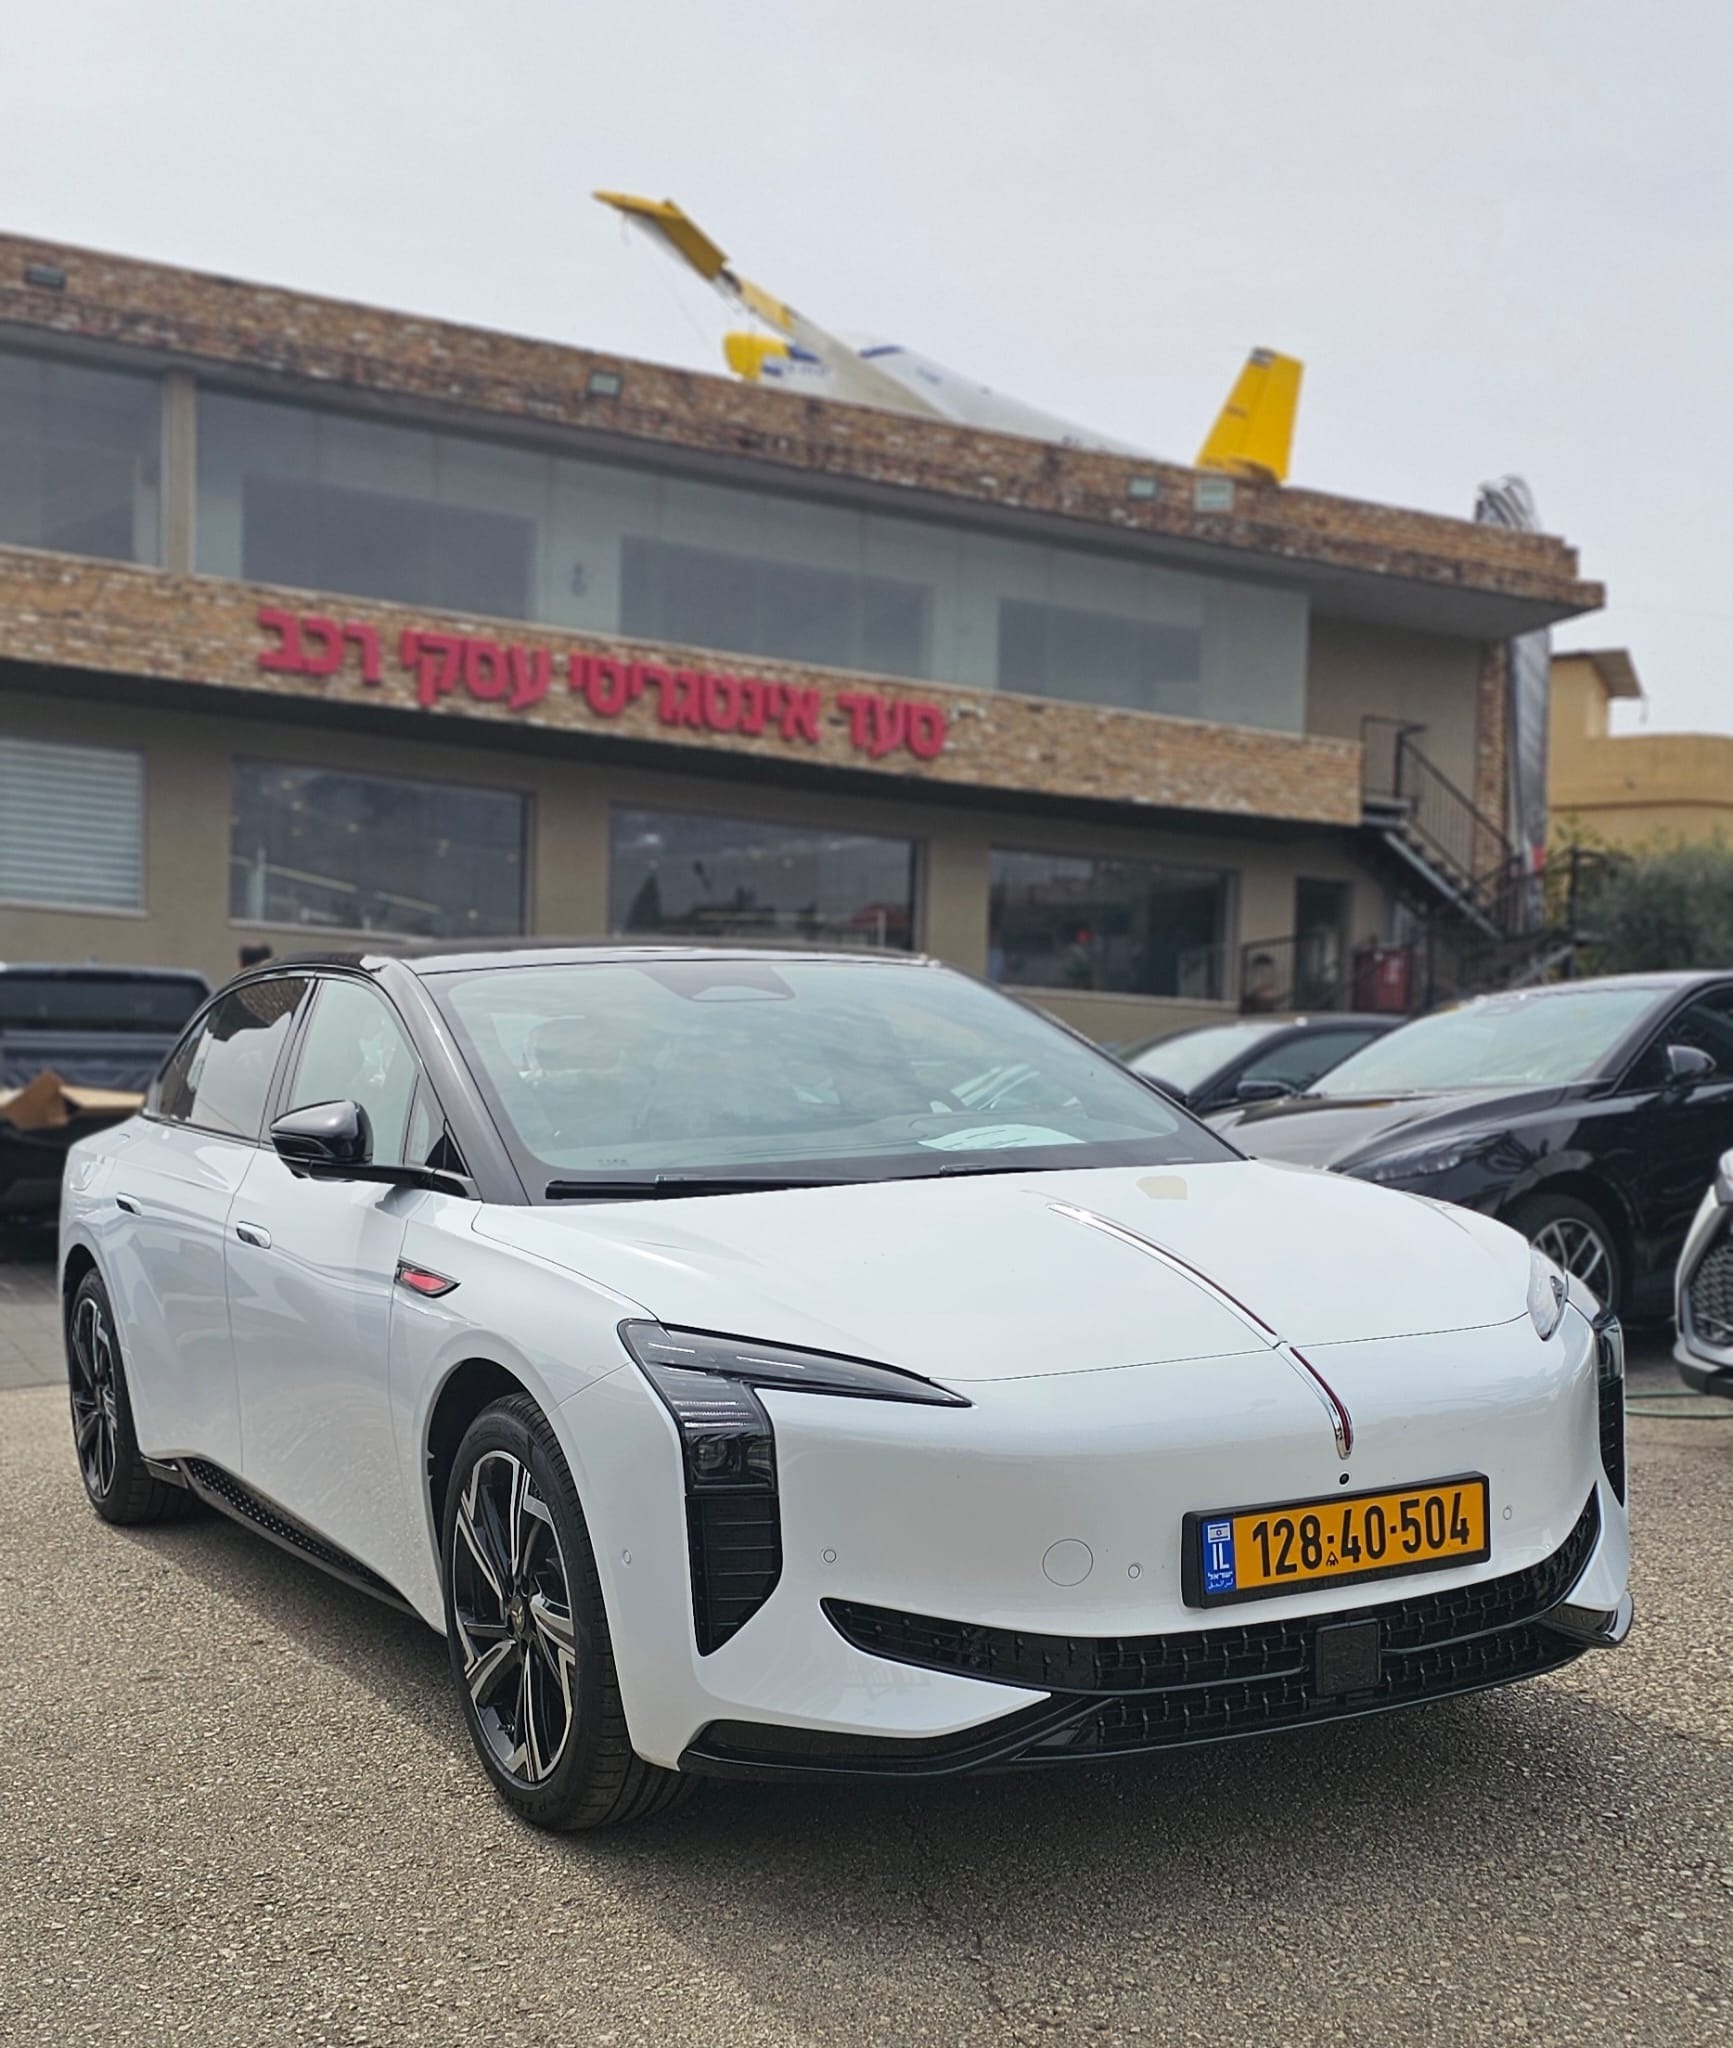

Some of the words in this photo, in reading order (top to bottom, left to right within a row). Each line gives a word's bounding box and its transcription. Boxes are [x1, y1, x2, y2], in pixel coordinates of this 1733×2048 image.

[258, 607, 381, 682] רכב
[401, 629, 552, 709] עסקי
[568, 653, 822, 741] אינטגריטי
[837, 692, 946, 758] סעד
[1212, 1542, 1230, 1570] IL
